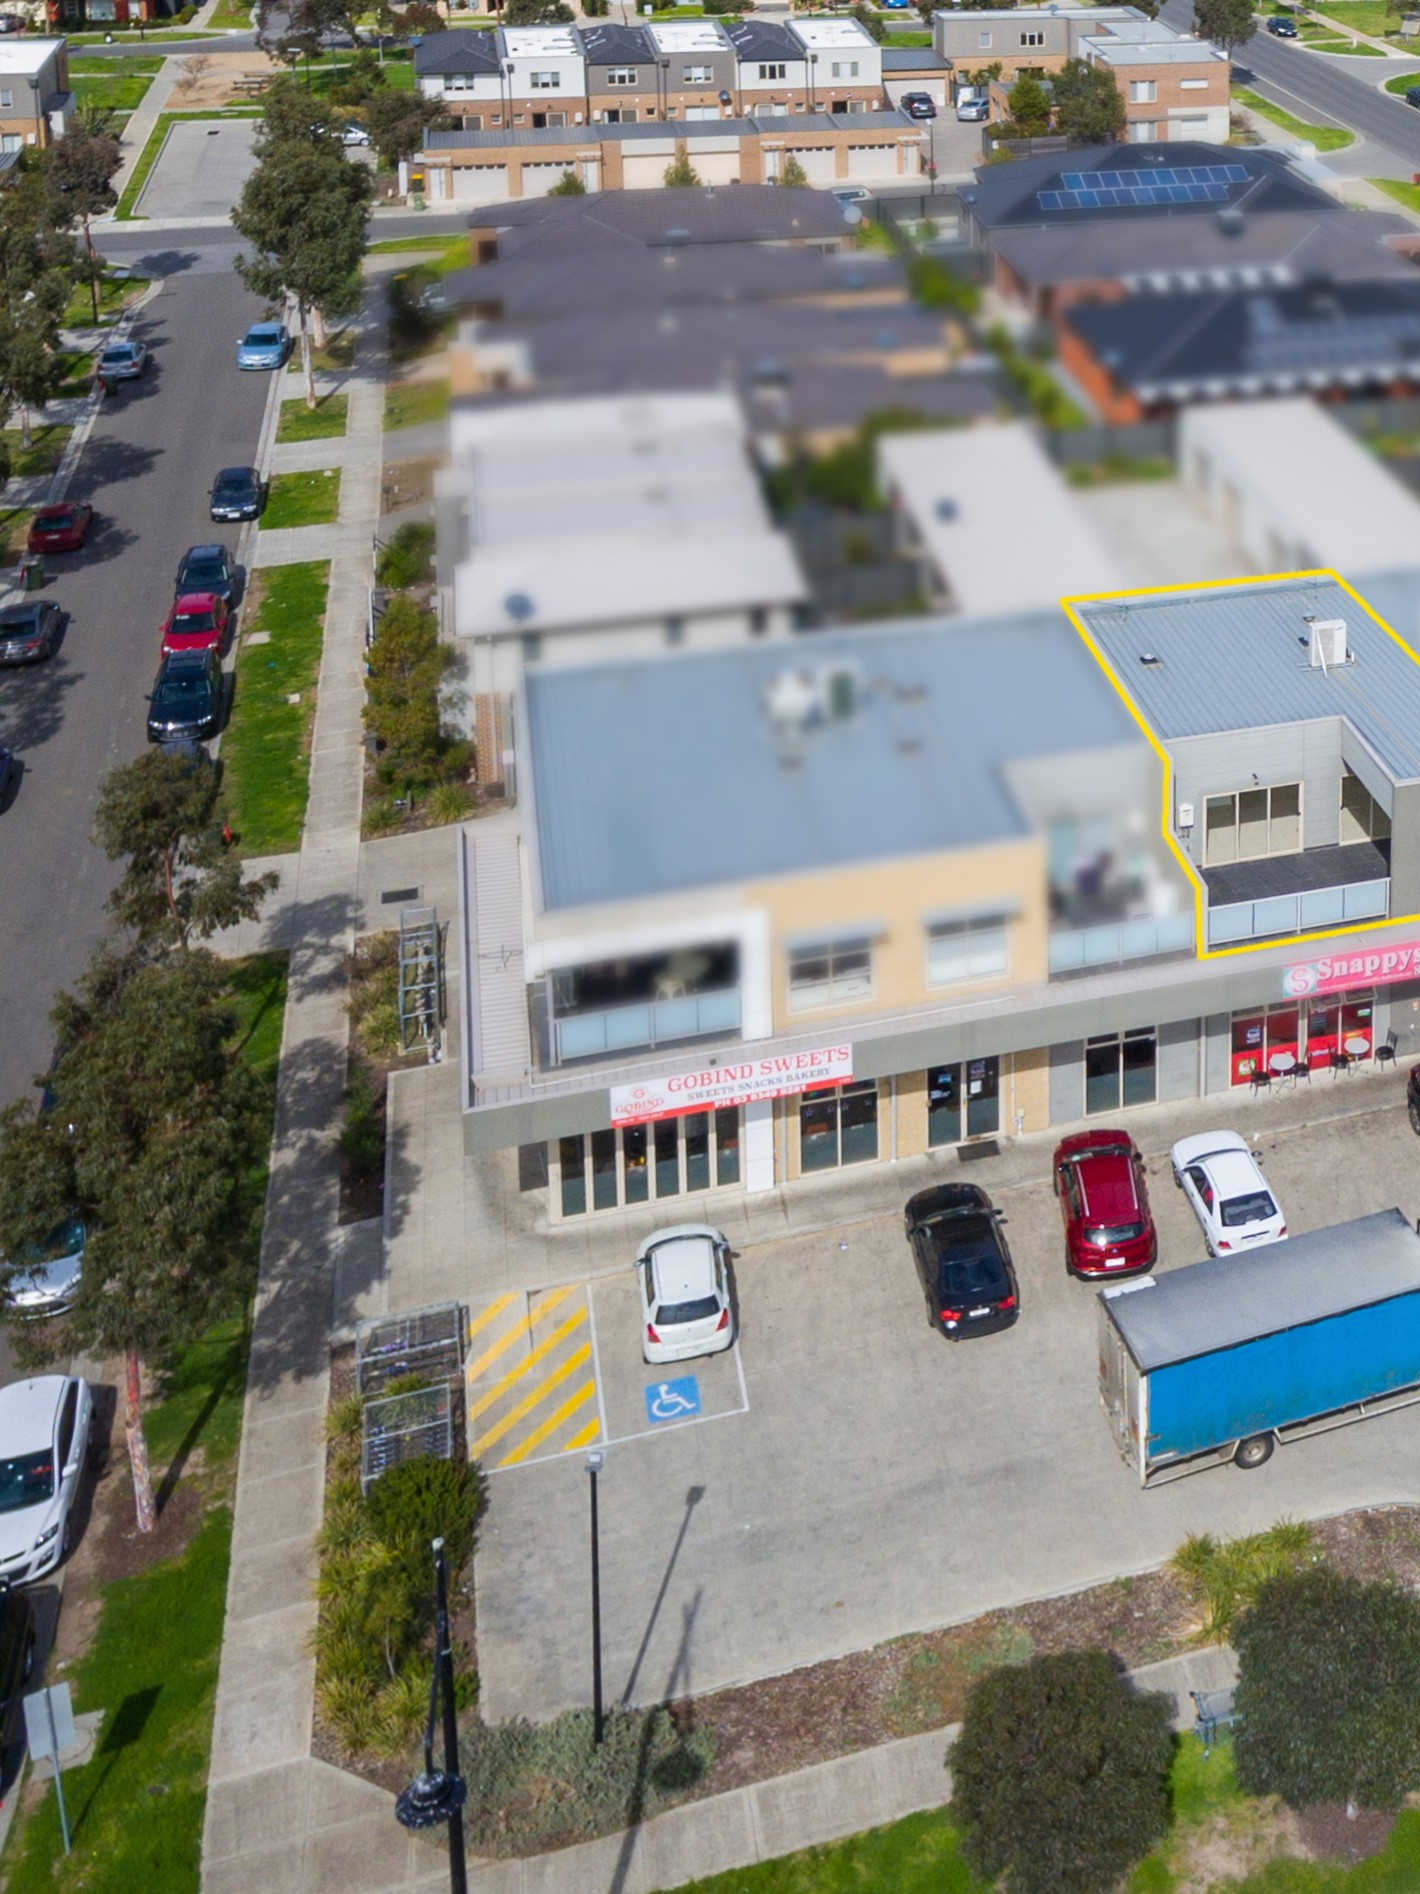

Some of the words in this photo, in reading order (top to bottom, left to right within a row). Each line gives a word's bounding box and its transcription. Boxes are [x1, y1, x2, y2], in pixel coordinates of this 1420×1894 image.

[668, 1064, 753, 1092] GOBIND
[760, 1046, 849, 1076] SWEETS
[687, 1085, 735, 1101] SWEETS
[738, 1077, 783, 1092] SNACKS
[786, 1067, 832, 1083] BAKERY
